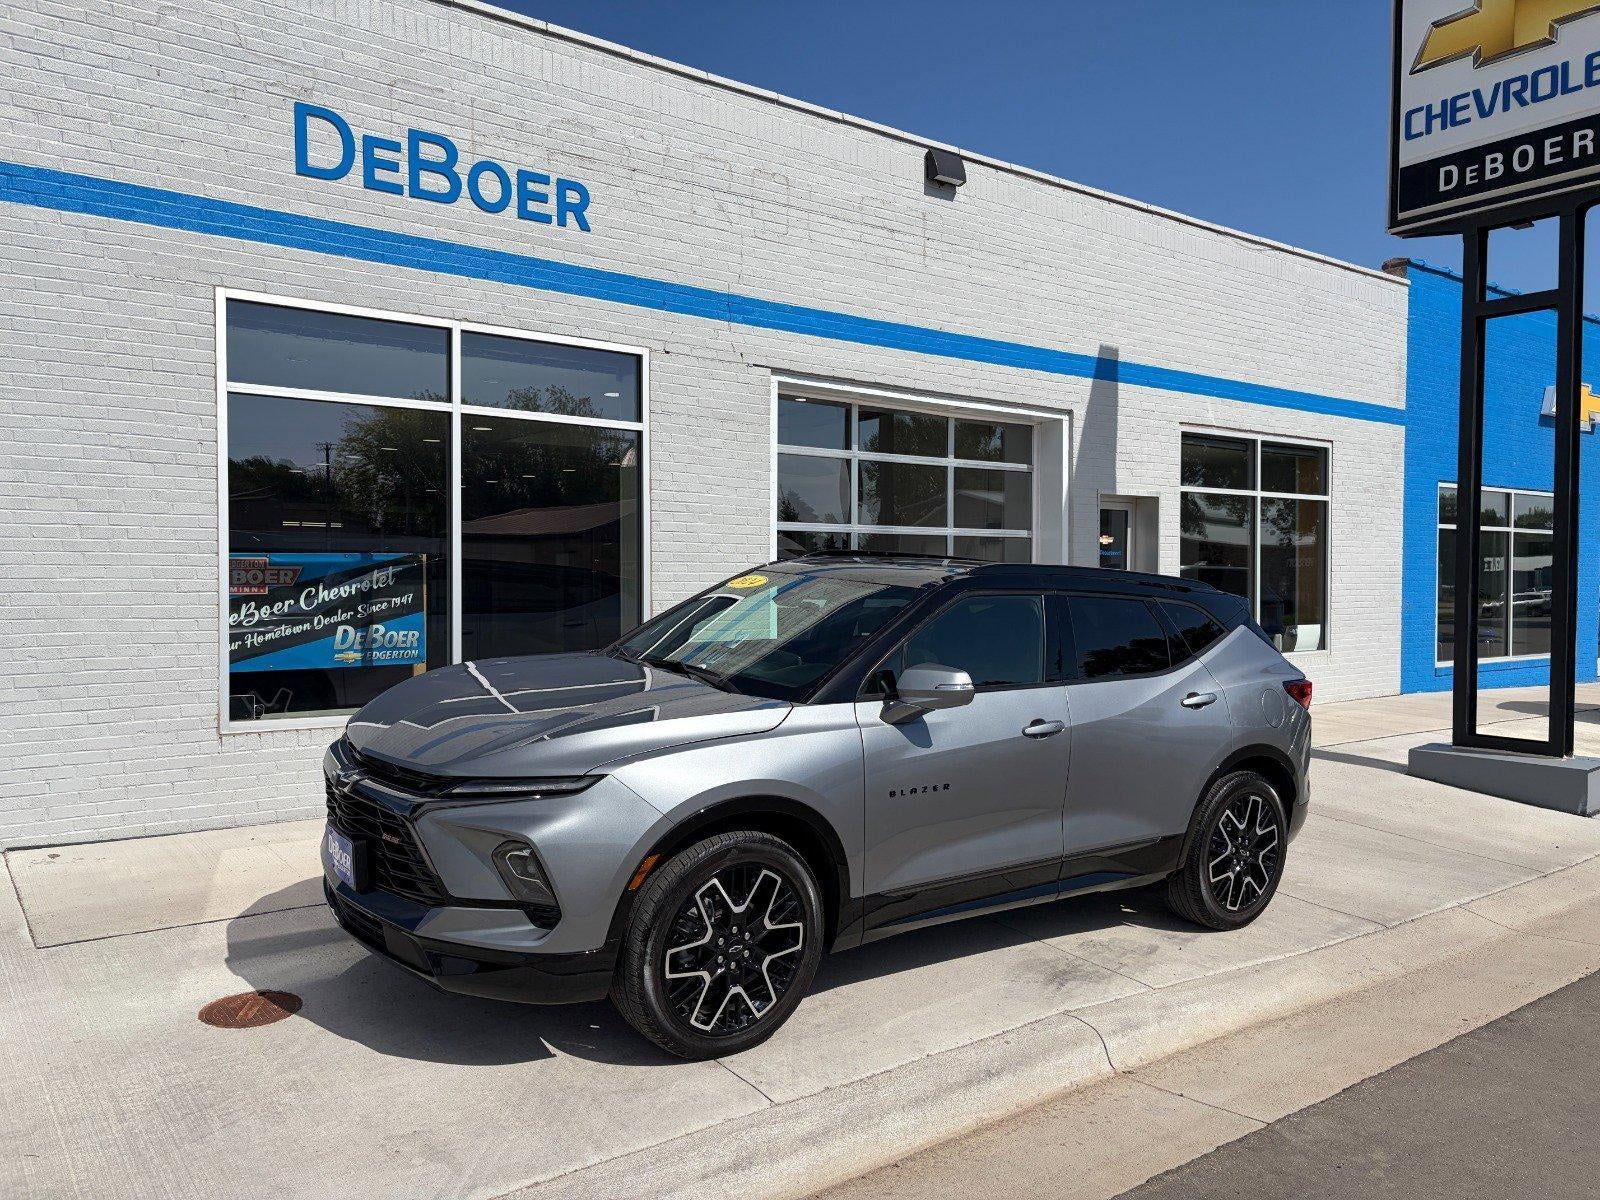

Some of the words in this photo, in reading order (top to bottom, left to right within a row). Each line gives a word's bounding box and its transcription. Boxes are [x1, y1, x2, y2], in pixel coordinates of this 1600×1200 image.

[1404, 50, 1600, 141] CHEVROLE
[229, 560, 265, 568] DGERTON
[231, 569, 294, 585] BOER
[229, 601, 294, 626] eBoer
[300, 565, 403, 611] Chevrolet
[244, 623, 311, 649] Hometown
[313, 608, 354, 630] Dealer
[357, 602, 389, 618] Since
[391, 593, 413, 608] 1947
[367, 649, 419, 660] EDGERTON
[889, 783, 950, 797] BLAZER
